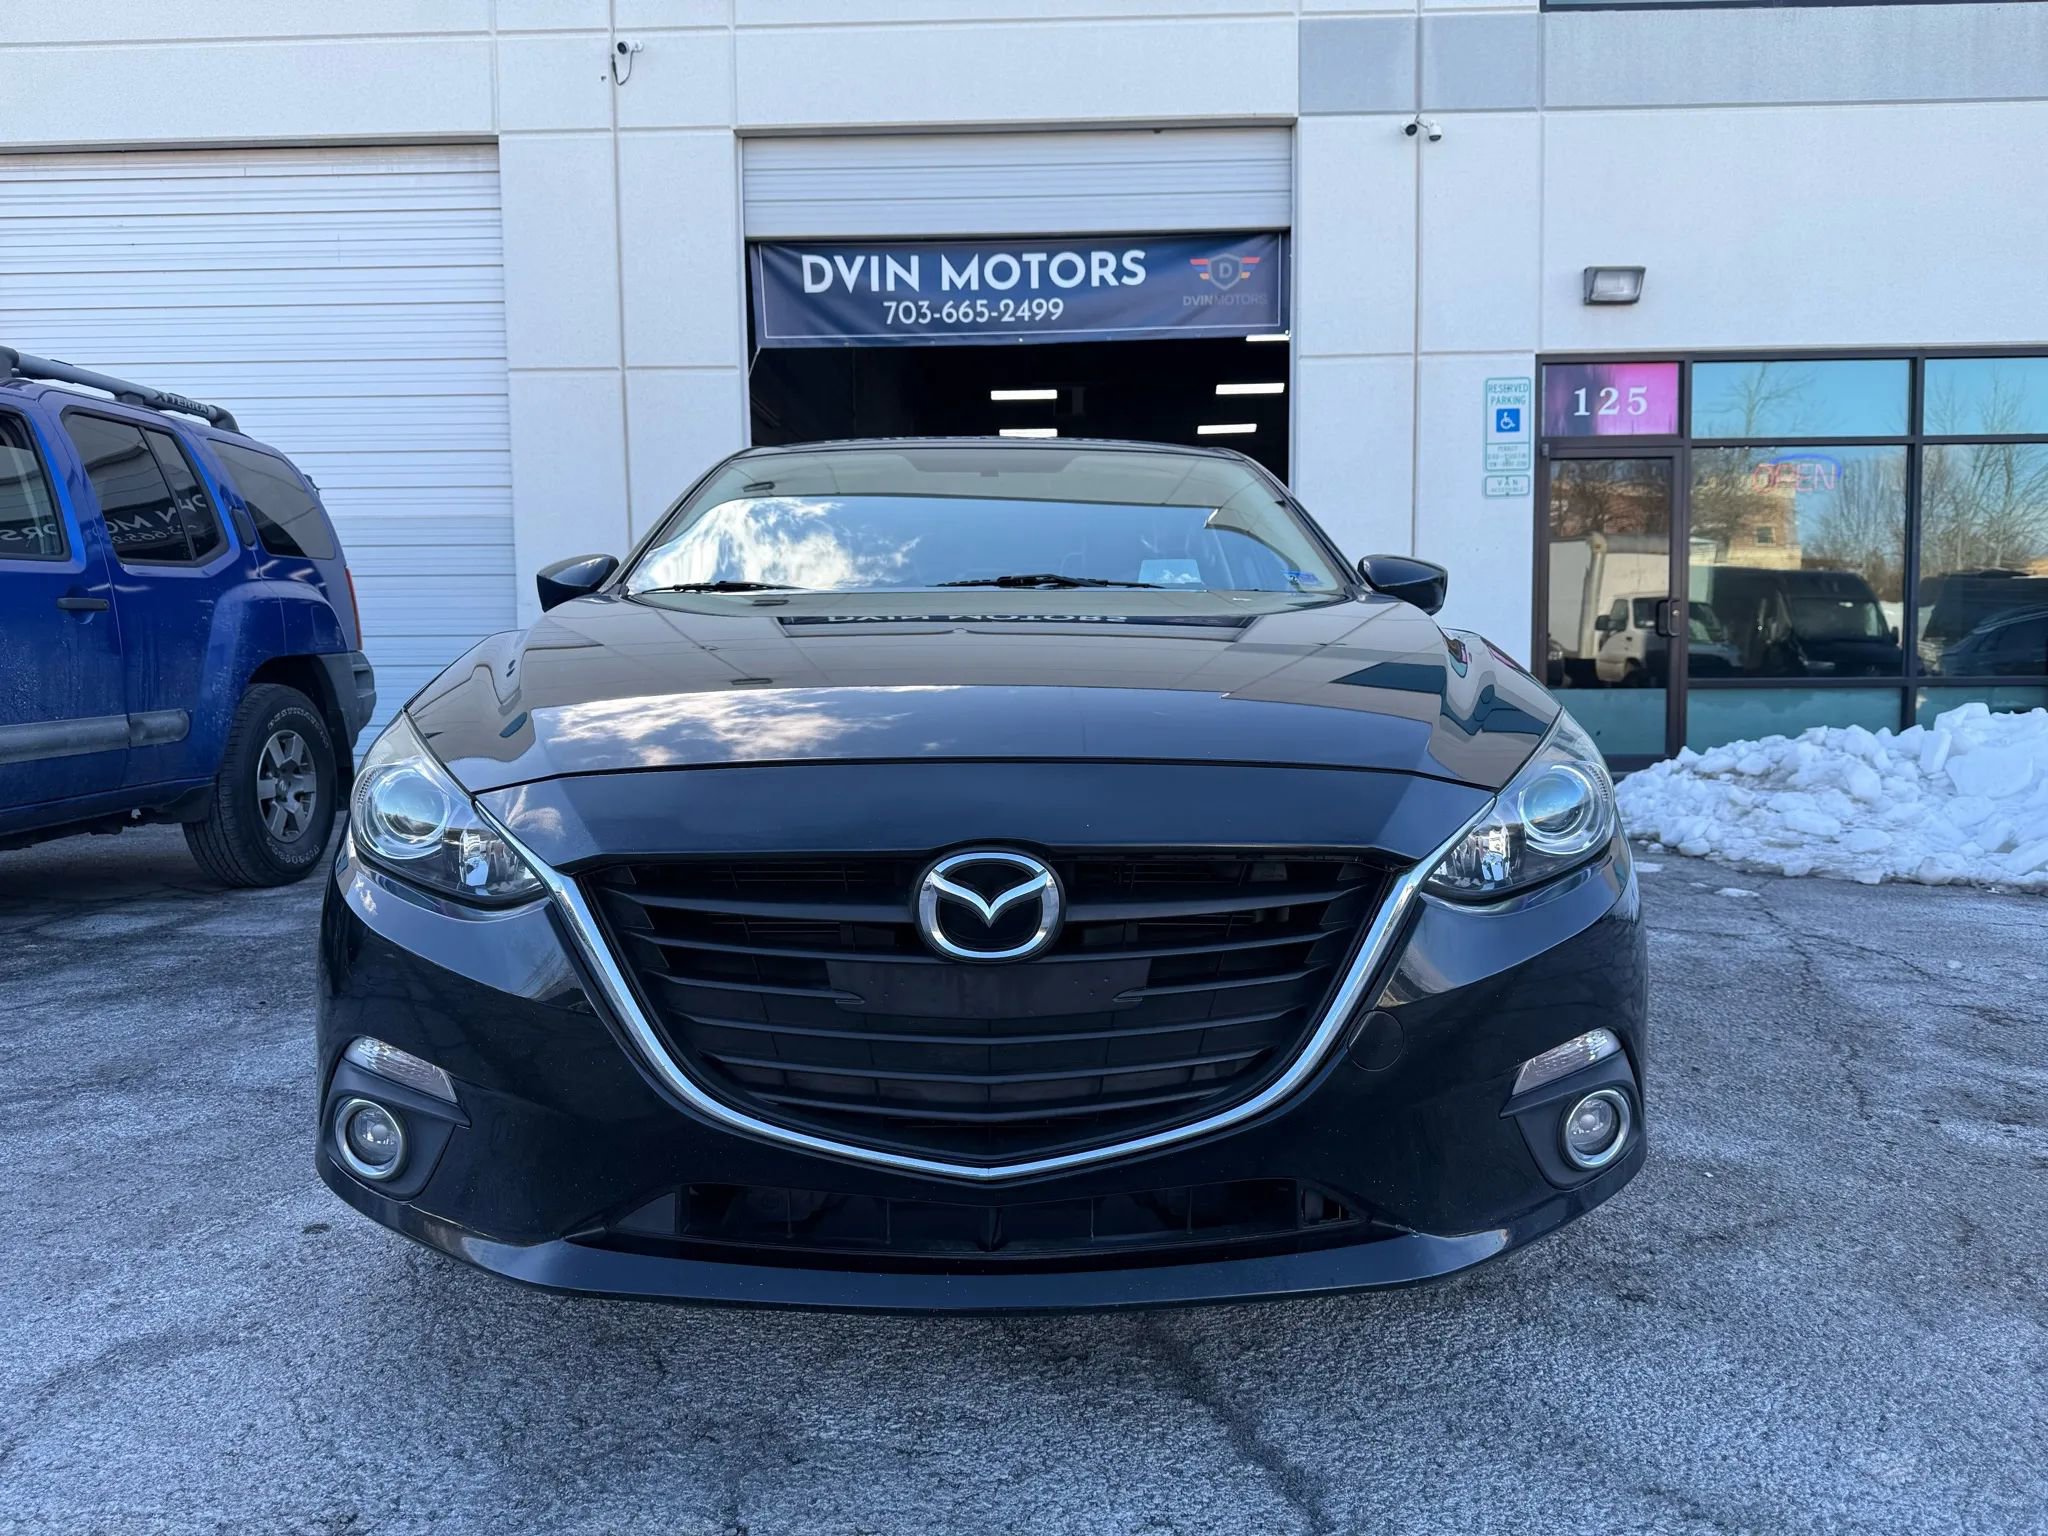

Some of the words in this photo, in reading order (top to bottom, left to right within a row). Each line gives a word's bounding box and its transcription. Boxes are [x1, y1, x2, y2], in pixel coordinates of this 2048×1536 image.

[801, 253, 920, 294] DVIN
[941, 249, 1147, 292] MOTORS
[1219, 263, 1233, 278] D
[882, 297, 1065, 325] 703-665-2499
[1488, 383, 1528, 393] RESERVED
[1490, 395, 1527, 406] PARKING
[1573, 386, 1648, 416] 125
[1752, 463, 1837, 495] OPEN
